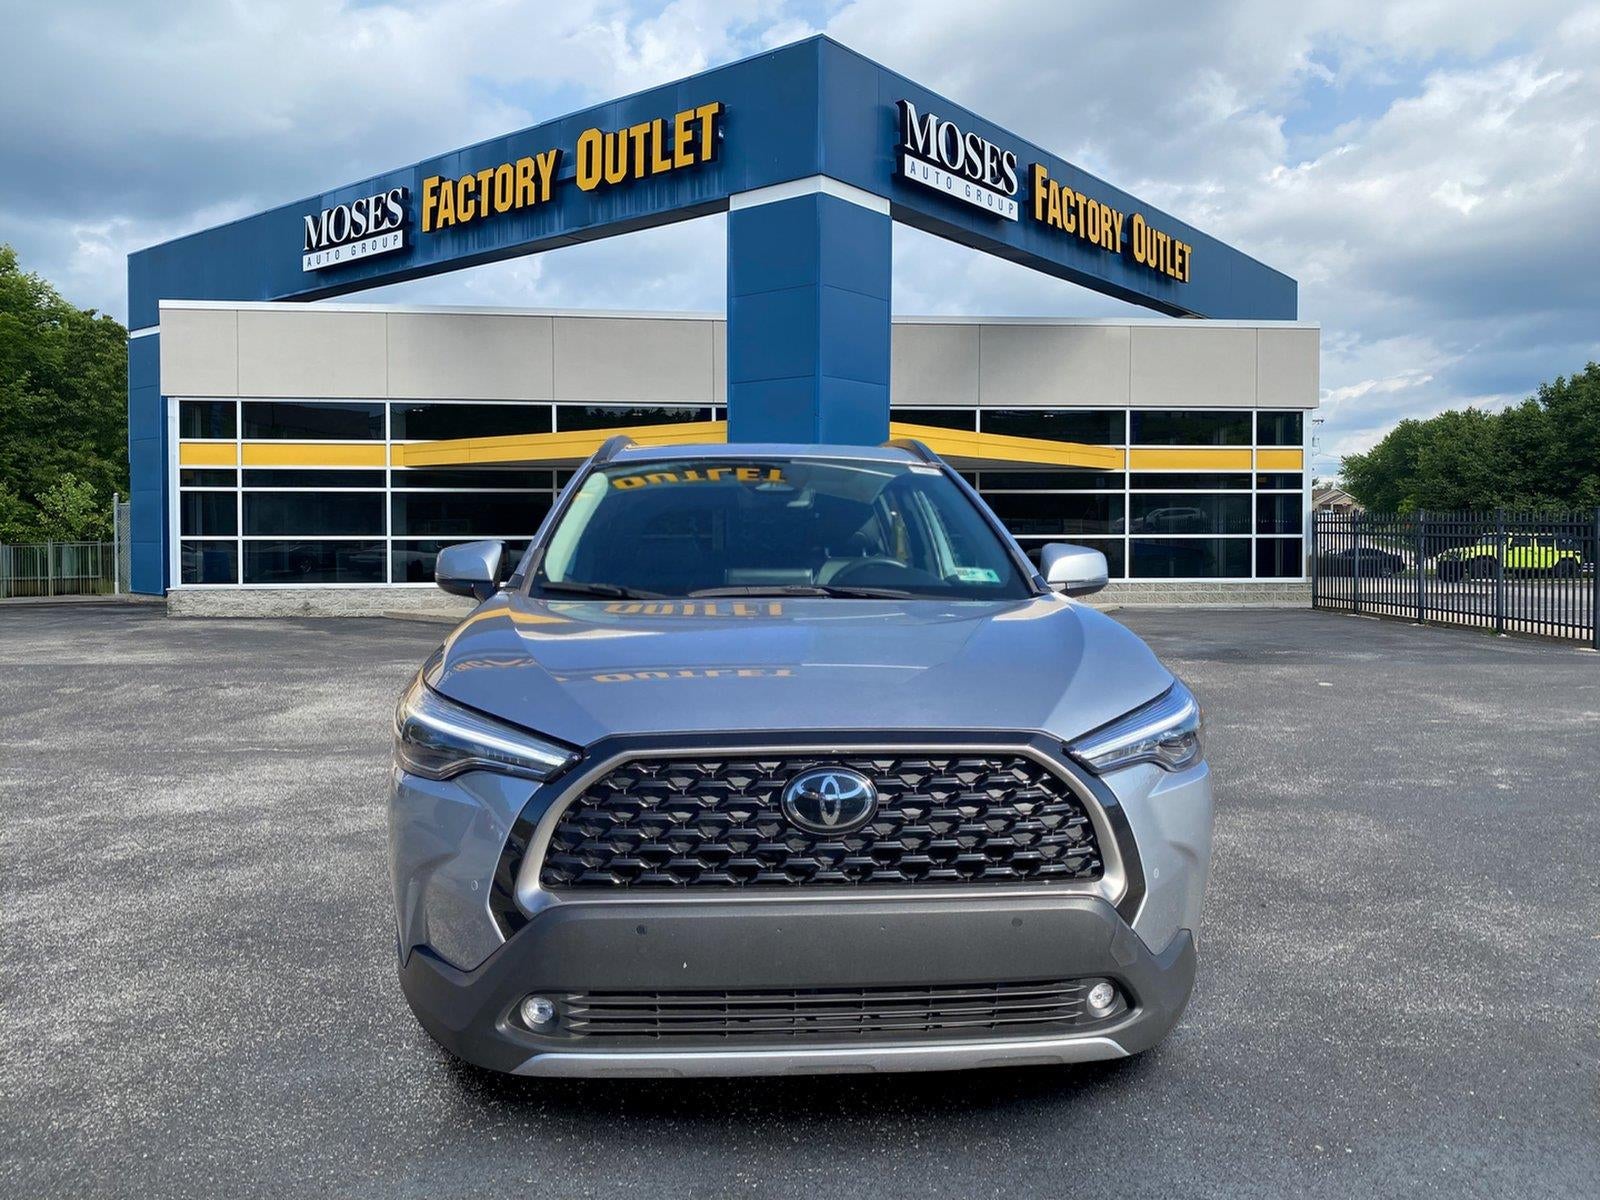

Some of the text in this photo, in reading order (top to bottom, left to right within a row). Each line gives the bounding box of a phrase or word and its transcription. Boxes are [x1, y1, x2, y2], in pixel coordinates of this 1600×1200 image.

[422, 102, 720, 232] FACTORY OUTLET
[904, 99, 1018, 196] MOSES
[910, 160, 1014, 214] AUTO GROUP
[303, 188, 404, 251] MOSES
[306, 234, 399, 267] AUTO GROUP
[1034, 163, 1192, 283] FACTORY OUTLET
